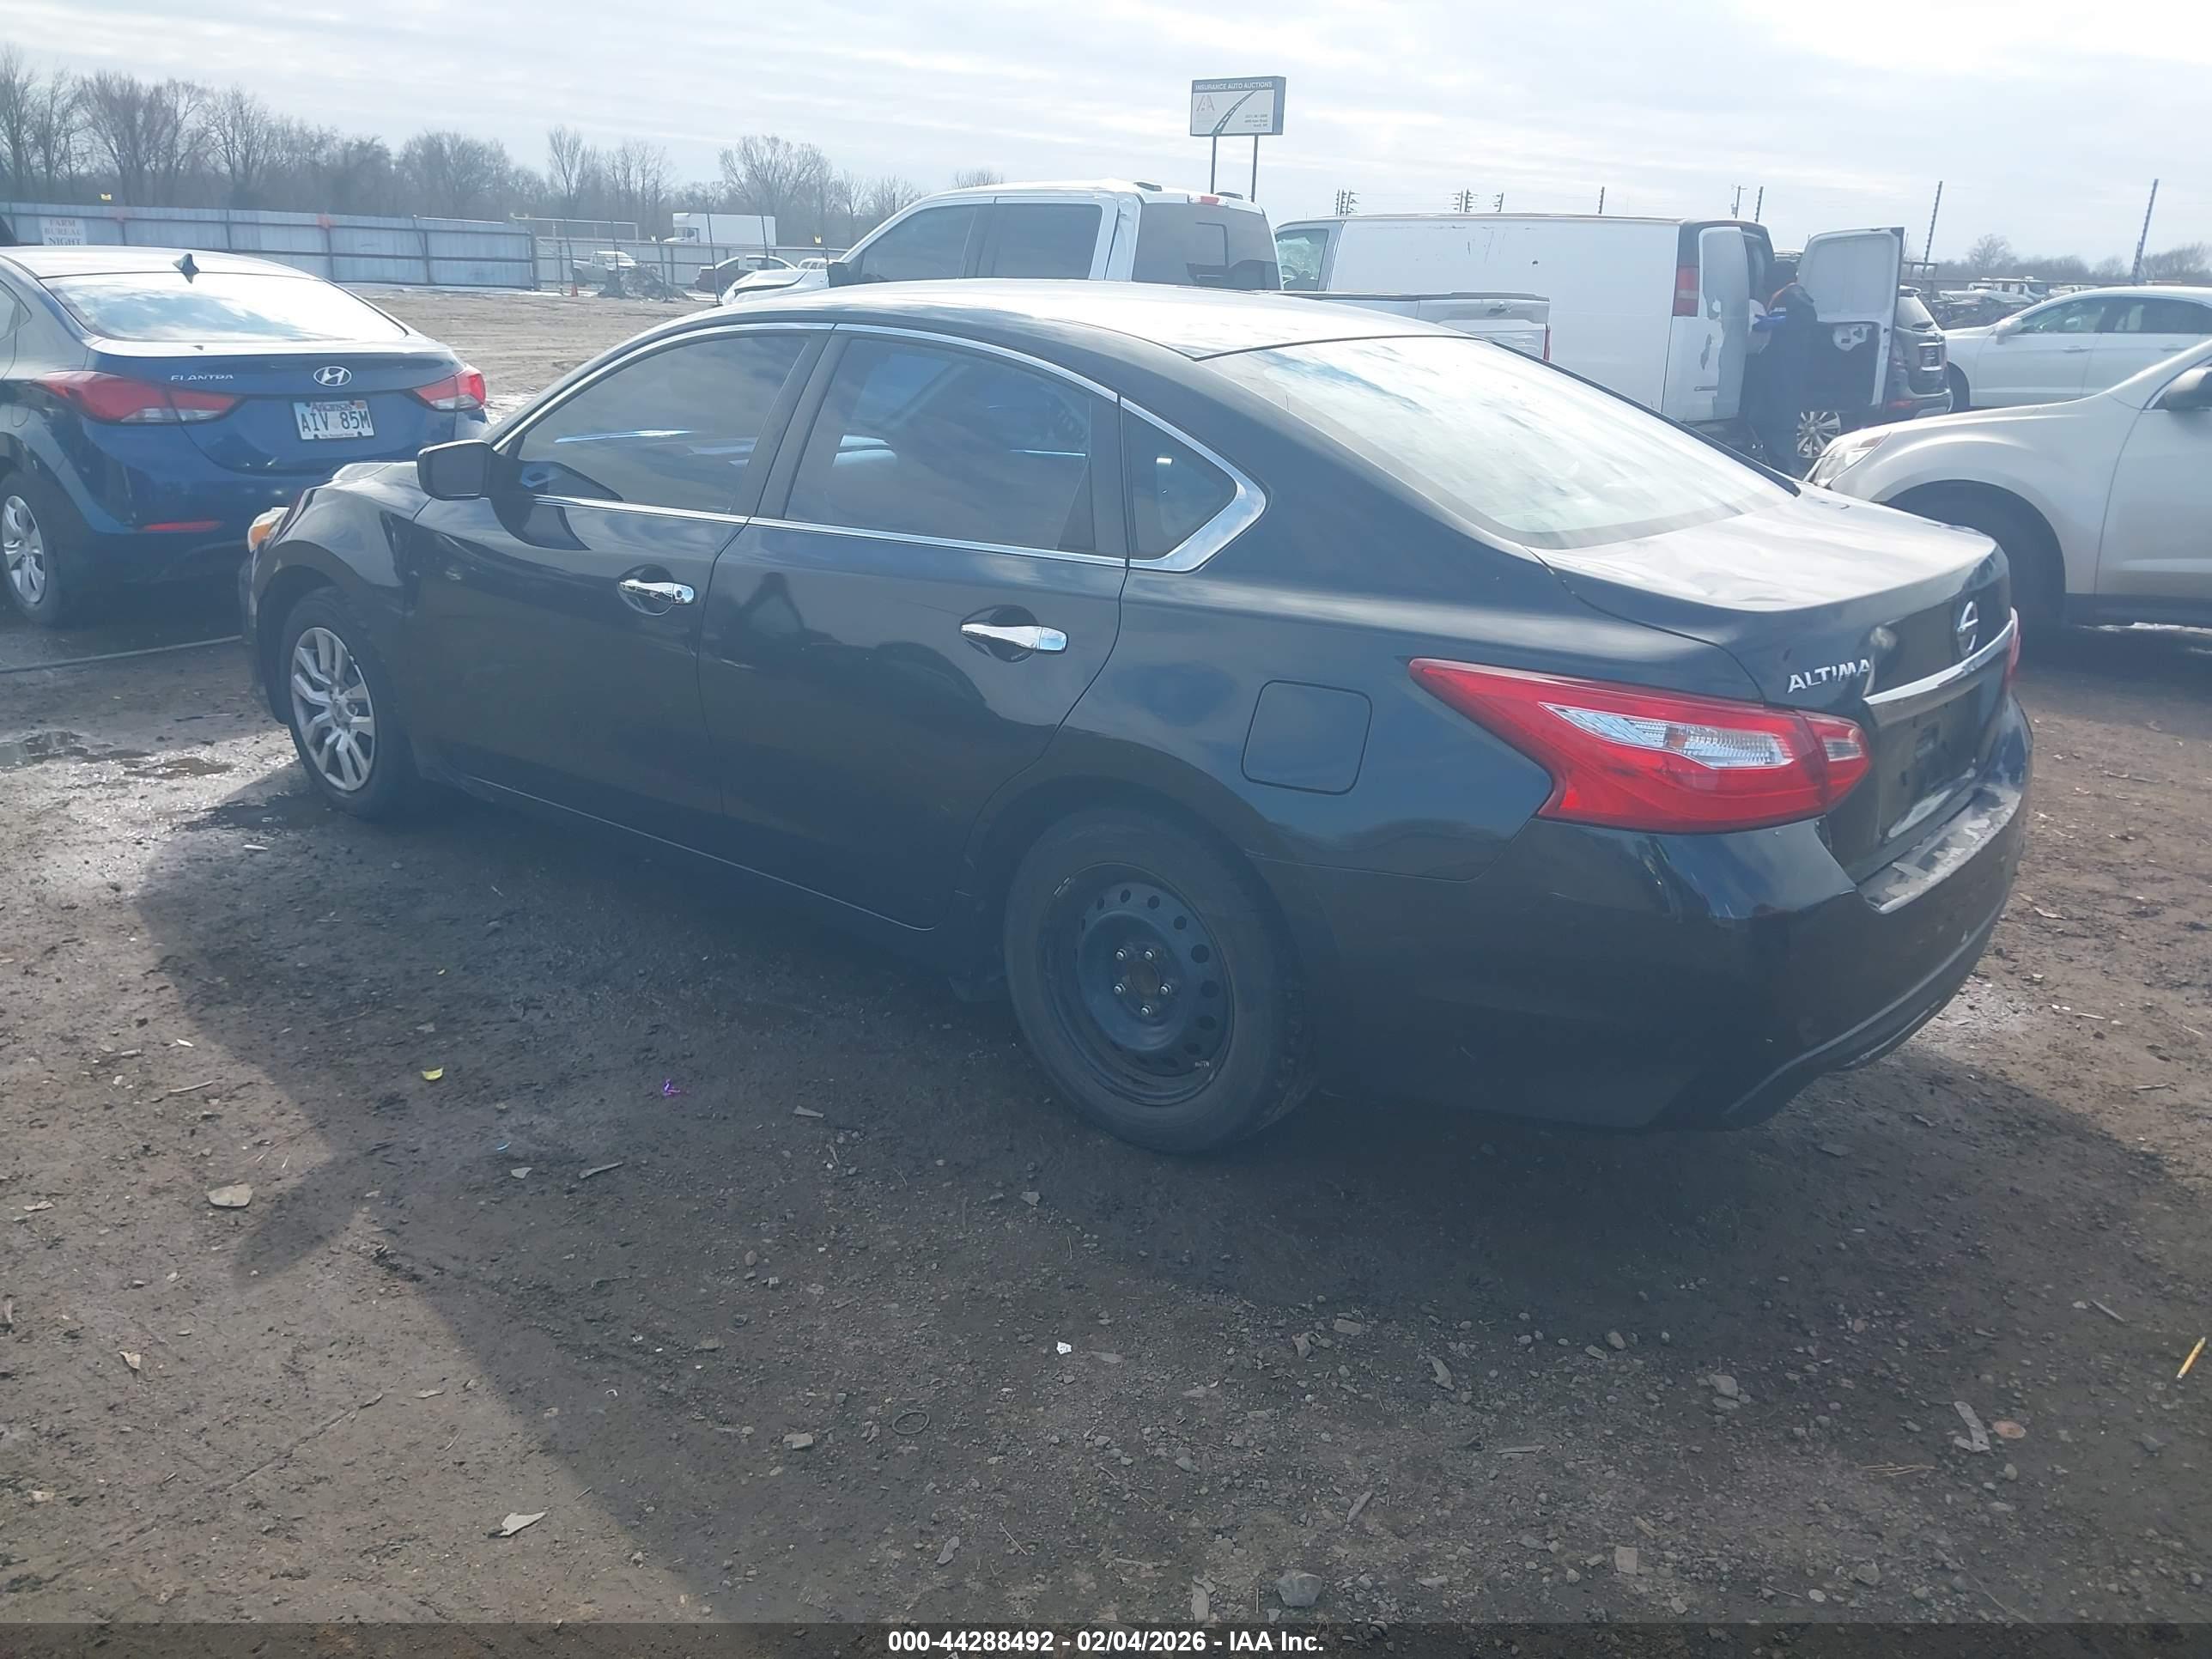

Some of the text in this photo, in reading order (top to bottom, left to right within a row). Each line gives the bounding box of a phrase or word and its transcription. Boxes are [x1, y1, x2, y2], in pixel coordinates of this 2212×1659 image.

[301, 410, 371, 432] AIV 85M
[1787, 659, 1870, 694] ALTIMA
